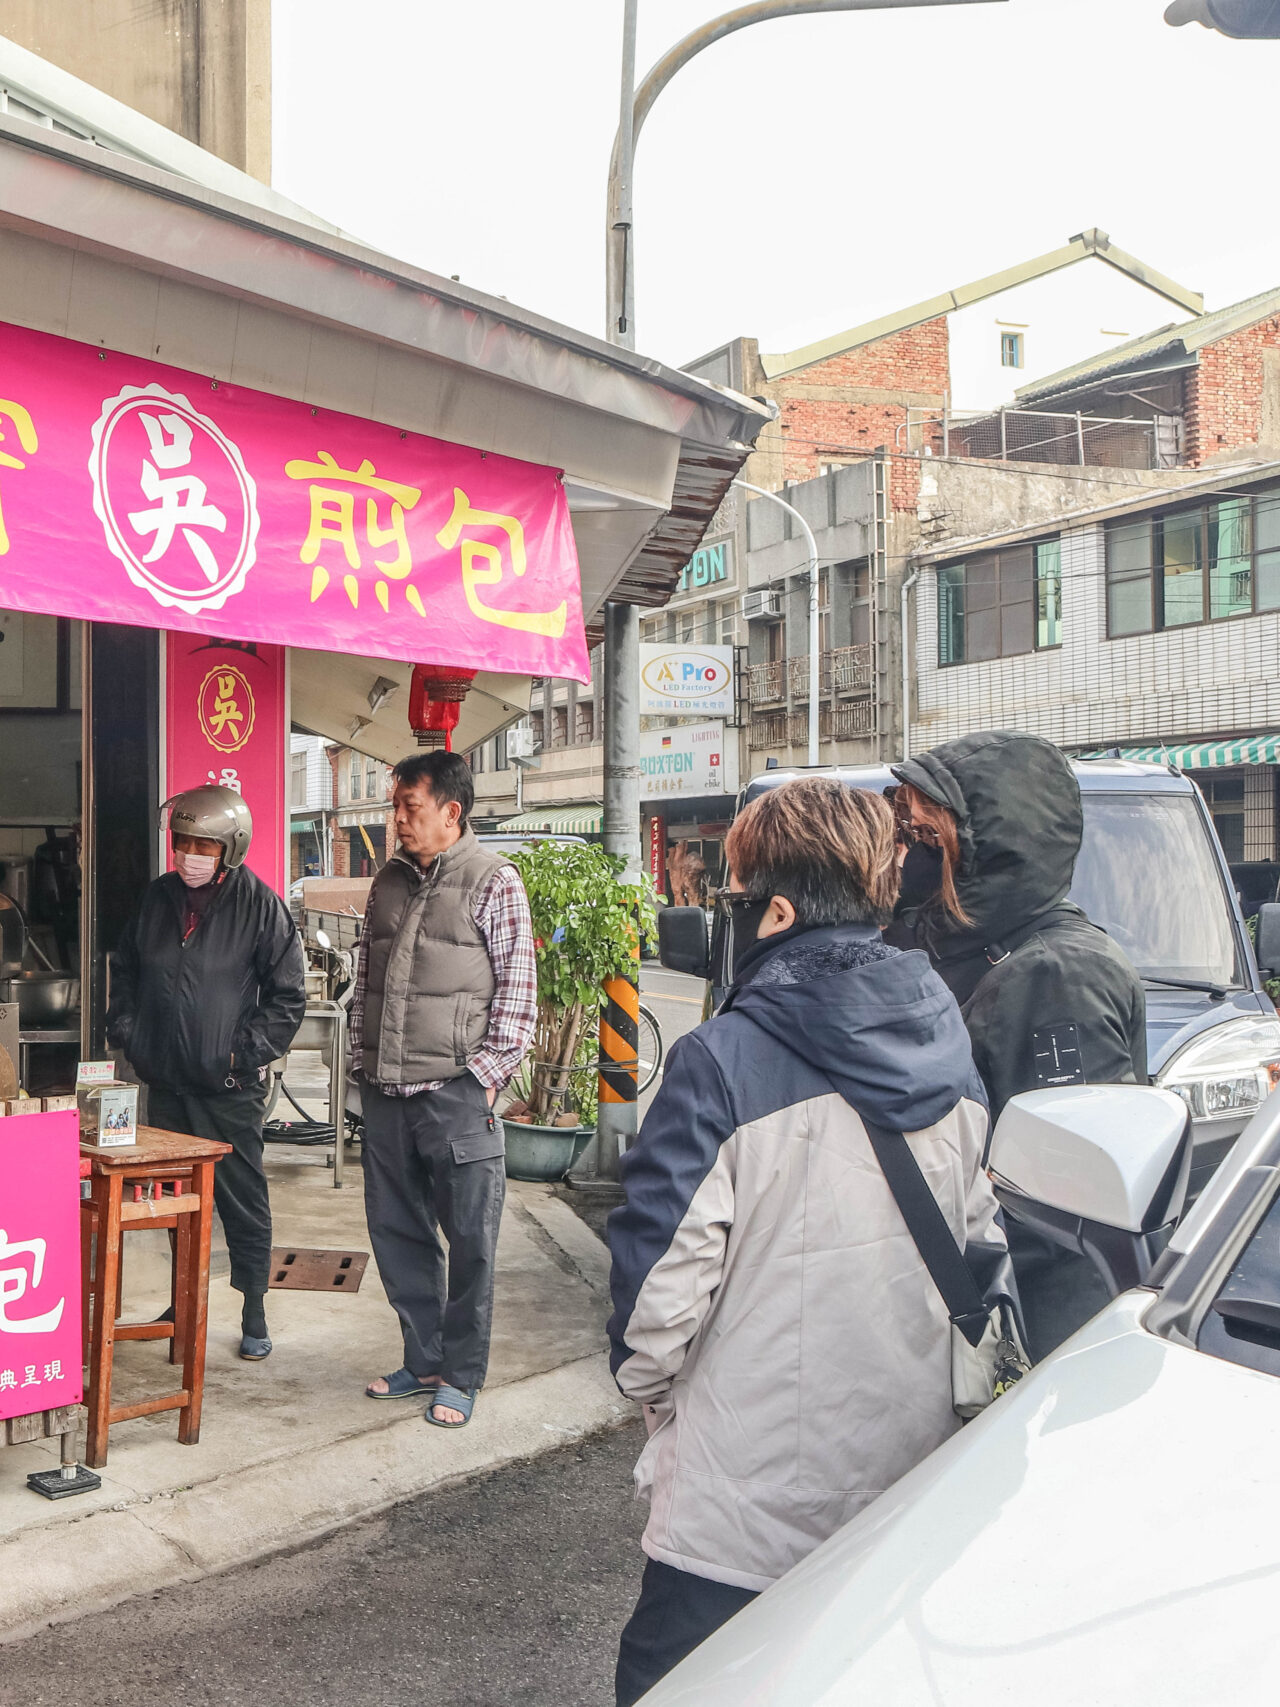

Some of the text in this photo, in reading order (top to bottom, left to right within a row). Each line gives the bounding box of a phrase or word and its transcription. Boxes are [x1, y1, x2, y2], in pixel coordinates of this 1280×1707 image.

[127, 412, 227, 583] 吳
[285, 450, 568, 638] 煎包
[682, 662, 717, 681] Pro
[681, 684, 713, 692] Factory
[209, 675, 244, 742] 吳
[691, 730, 720, 743] LIGHTING
[640, 752, 693, 775] BUXTON
